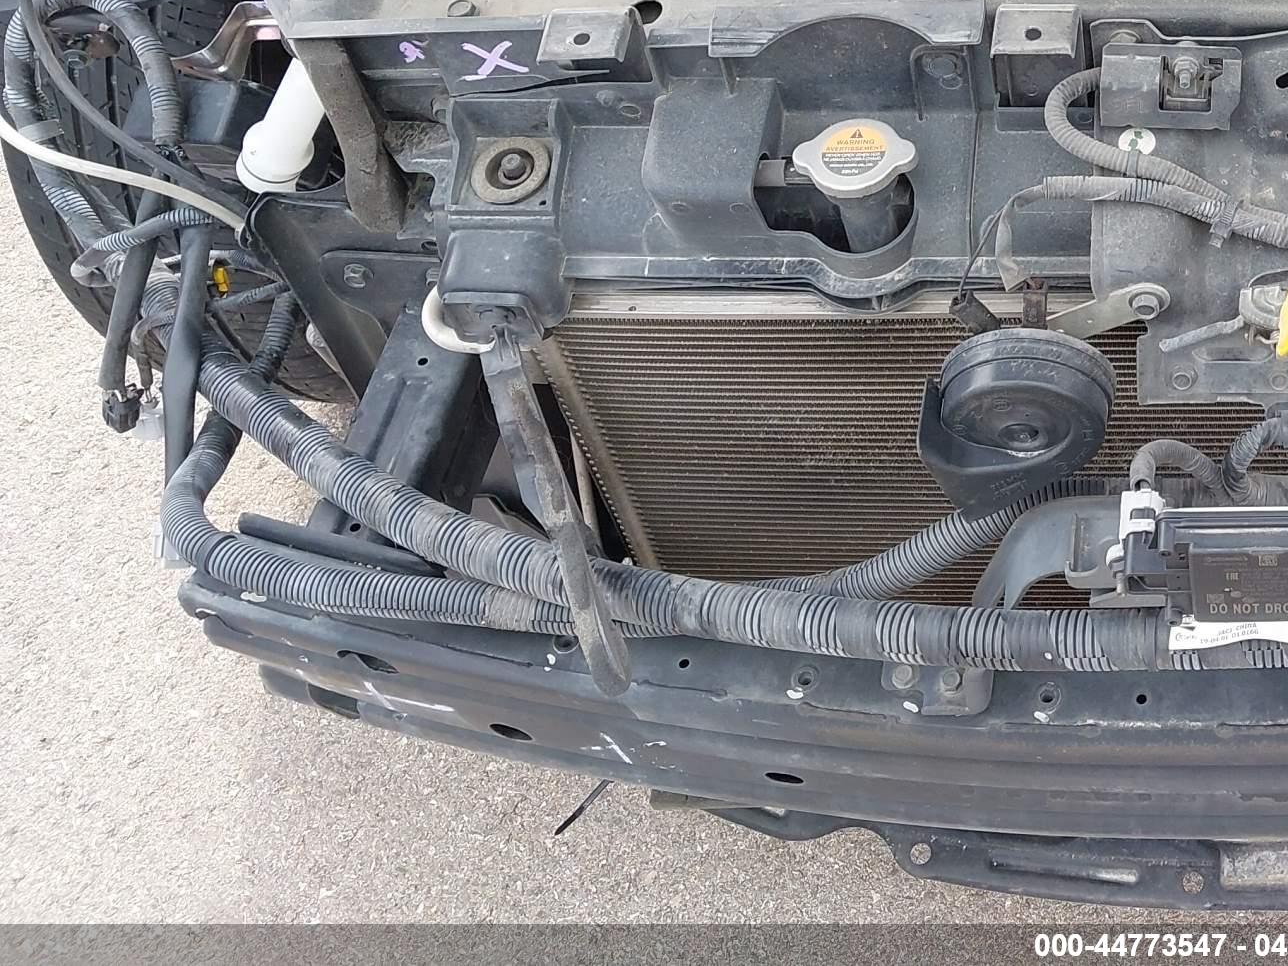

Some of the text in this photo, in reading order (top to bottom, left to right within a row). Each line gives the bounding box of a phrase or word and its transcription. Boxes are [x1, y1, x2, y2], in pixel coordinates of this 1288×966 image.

[836, 138, 875, 146] WARNING
[1209, 603, 1228, 614] DO
[1233, 603, 1260, 614] NOT
